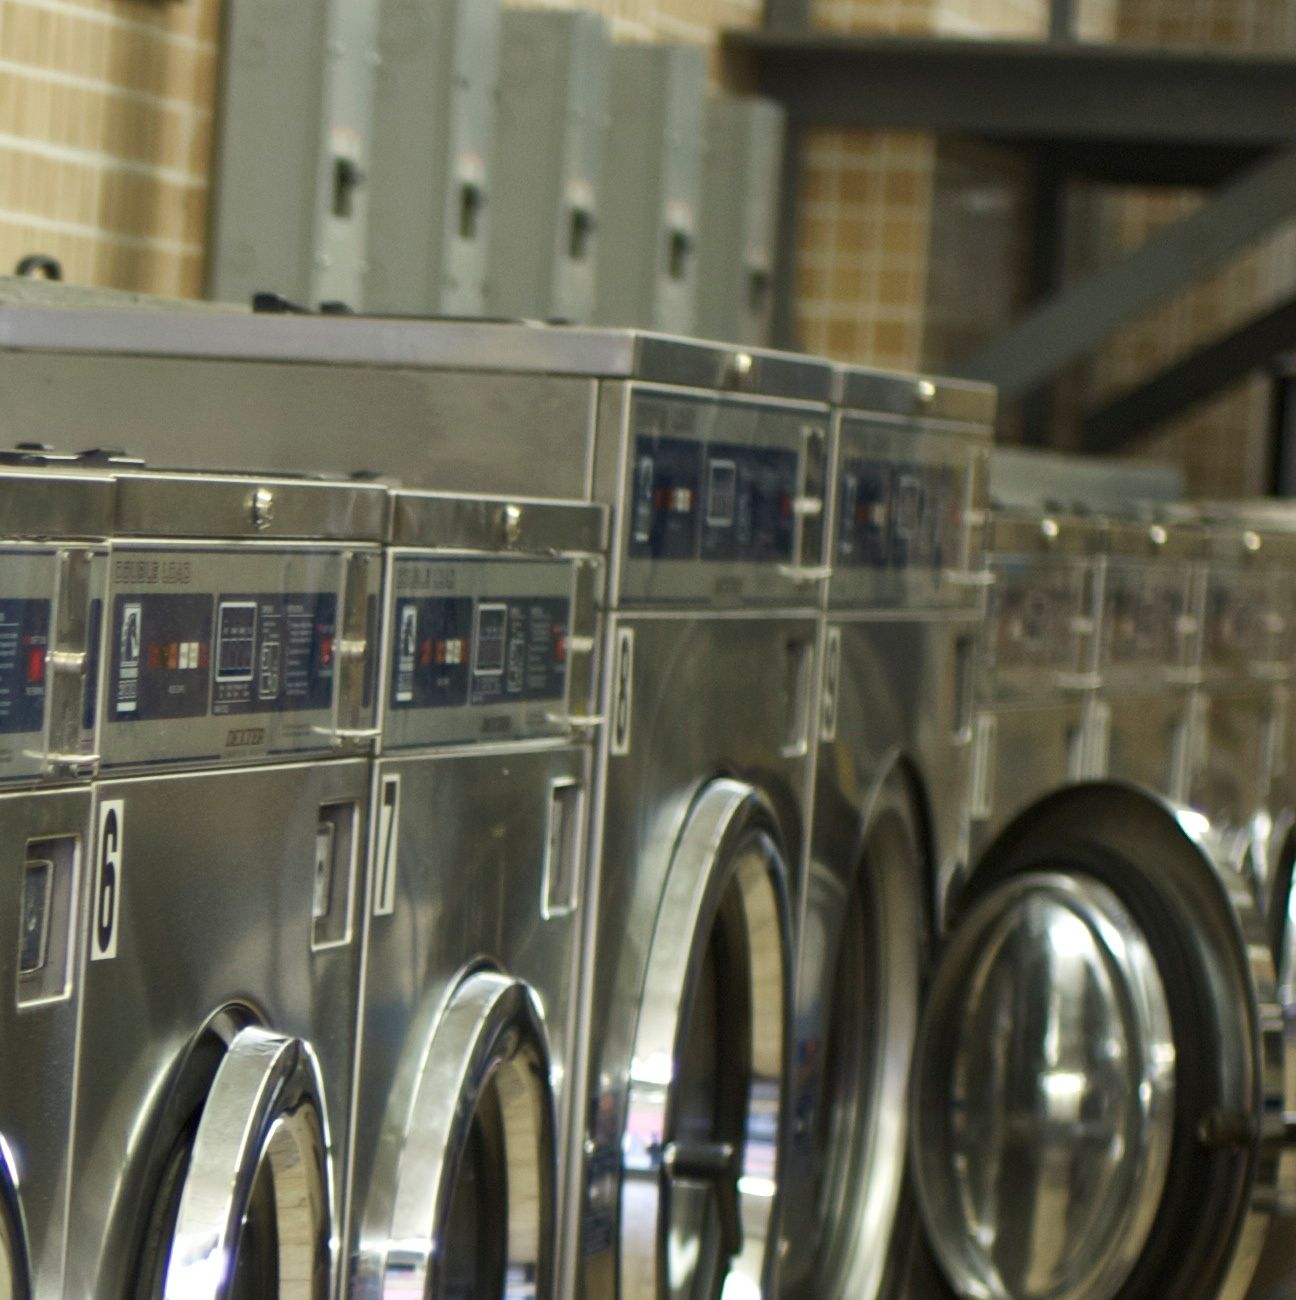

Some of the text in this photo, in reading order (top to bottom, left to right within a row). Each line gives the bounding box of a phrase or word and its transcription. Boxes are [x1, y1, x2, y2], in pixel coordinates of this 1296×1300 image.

[224, 728, 266, 747] DEXTER
[98, 808, 118, 952] 6
[379, 781, 396, 910] 7
